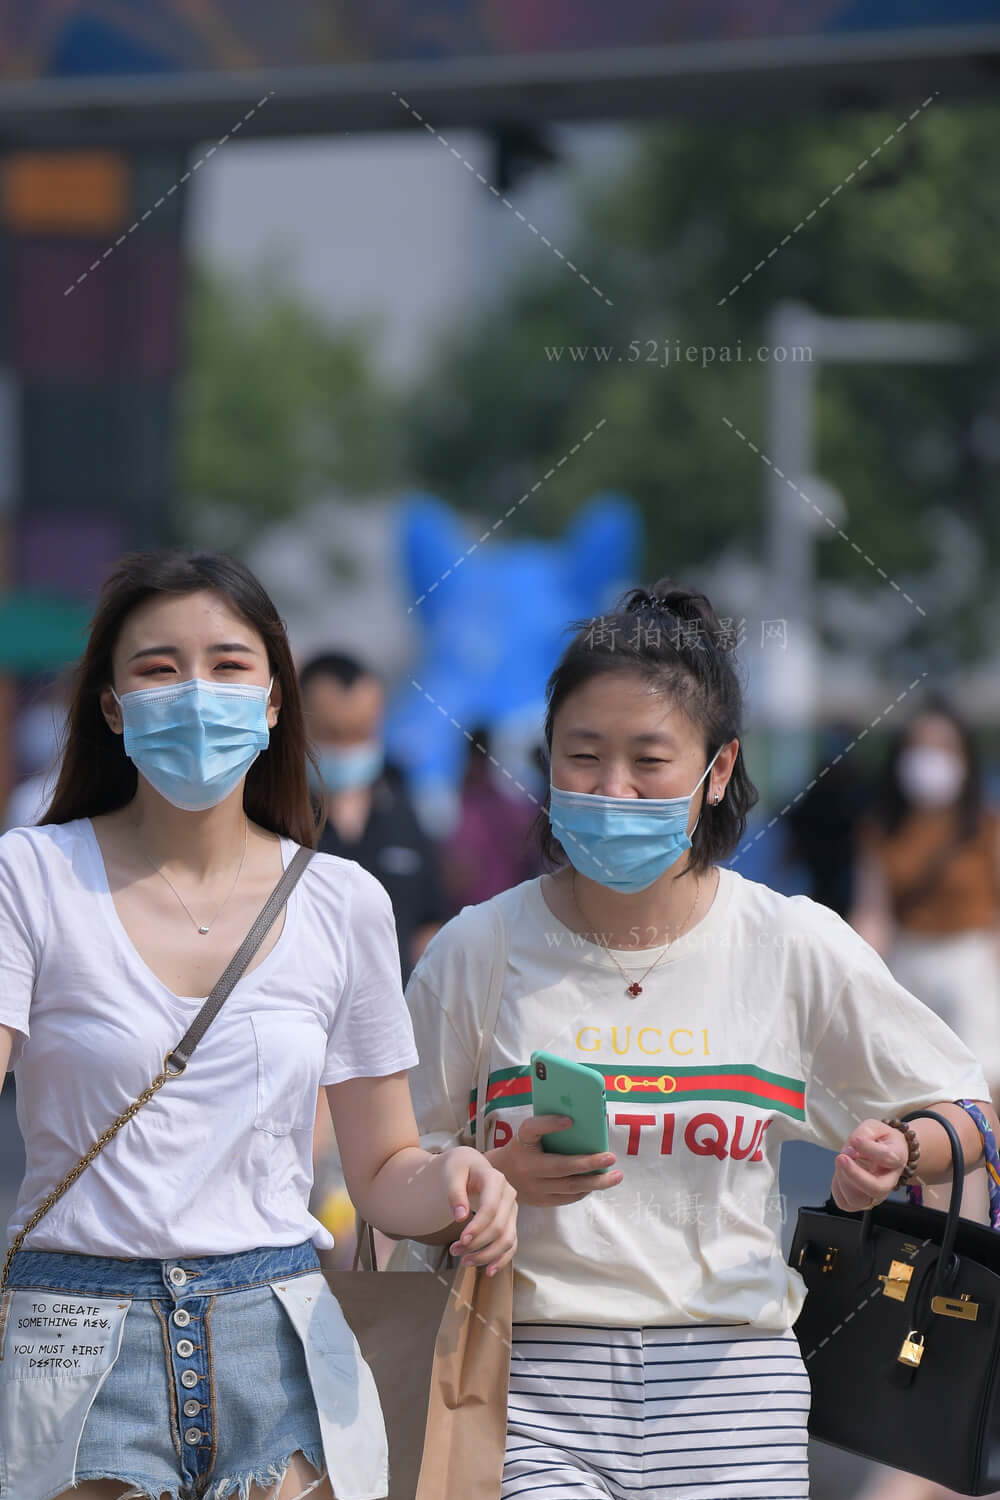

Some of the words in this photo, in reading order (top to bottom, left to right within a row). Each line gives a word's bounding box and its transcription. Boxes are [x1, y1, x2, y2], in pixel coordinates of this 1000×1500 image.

[576, 1026, 711, 1056] GUCCI
[32, 1304, 47, 1313] TO
[52, 1304, 100, 1316] CREATE
[17, 1317, 78, 1329] SOMETHING
[14, 1345, 35, 1355] YOU
[38, 1344, 65, 1354] MUST
[72, 1345, 105, 1356] FIRST
